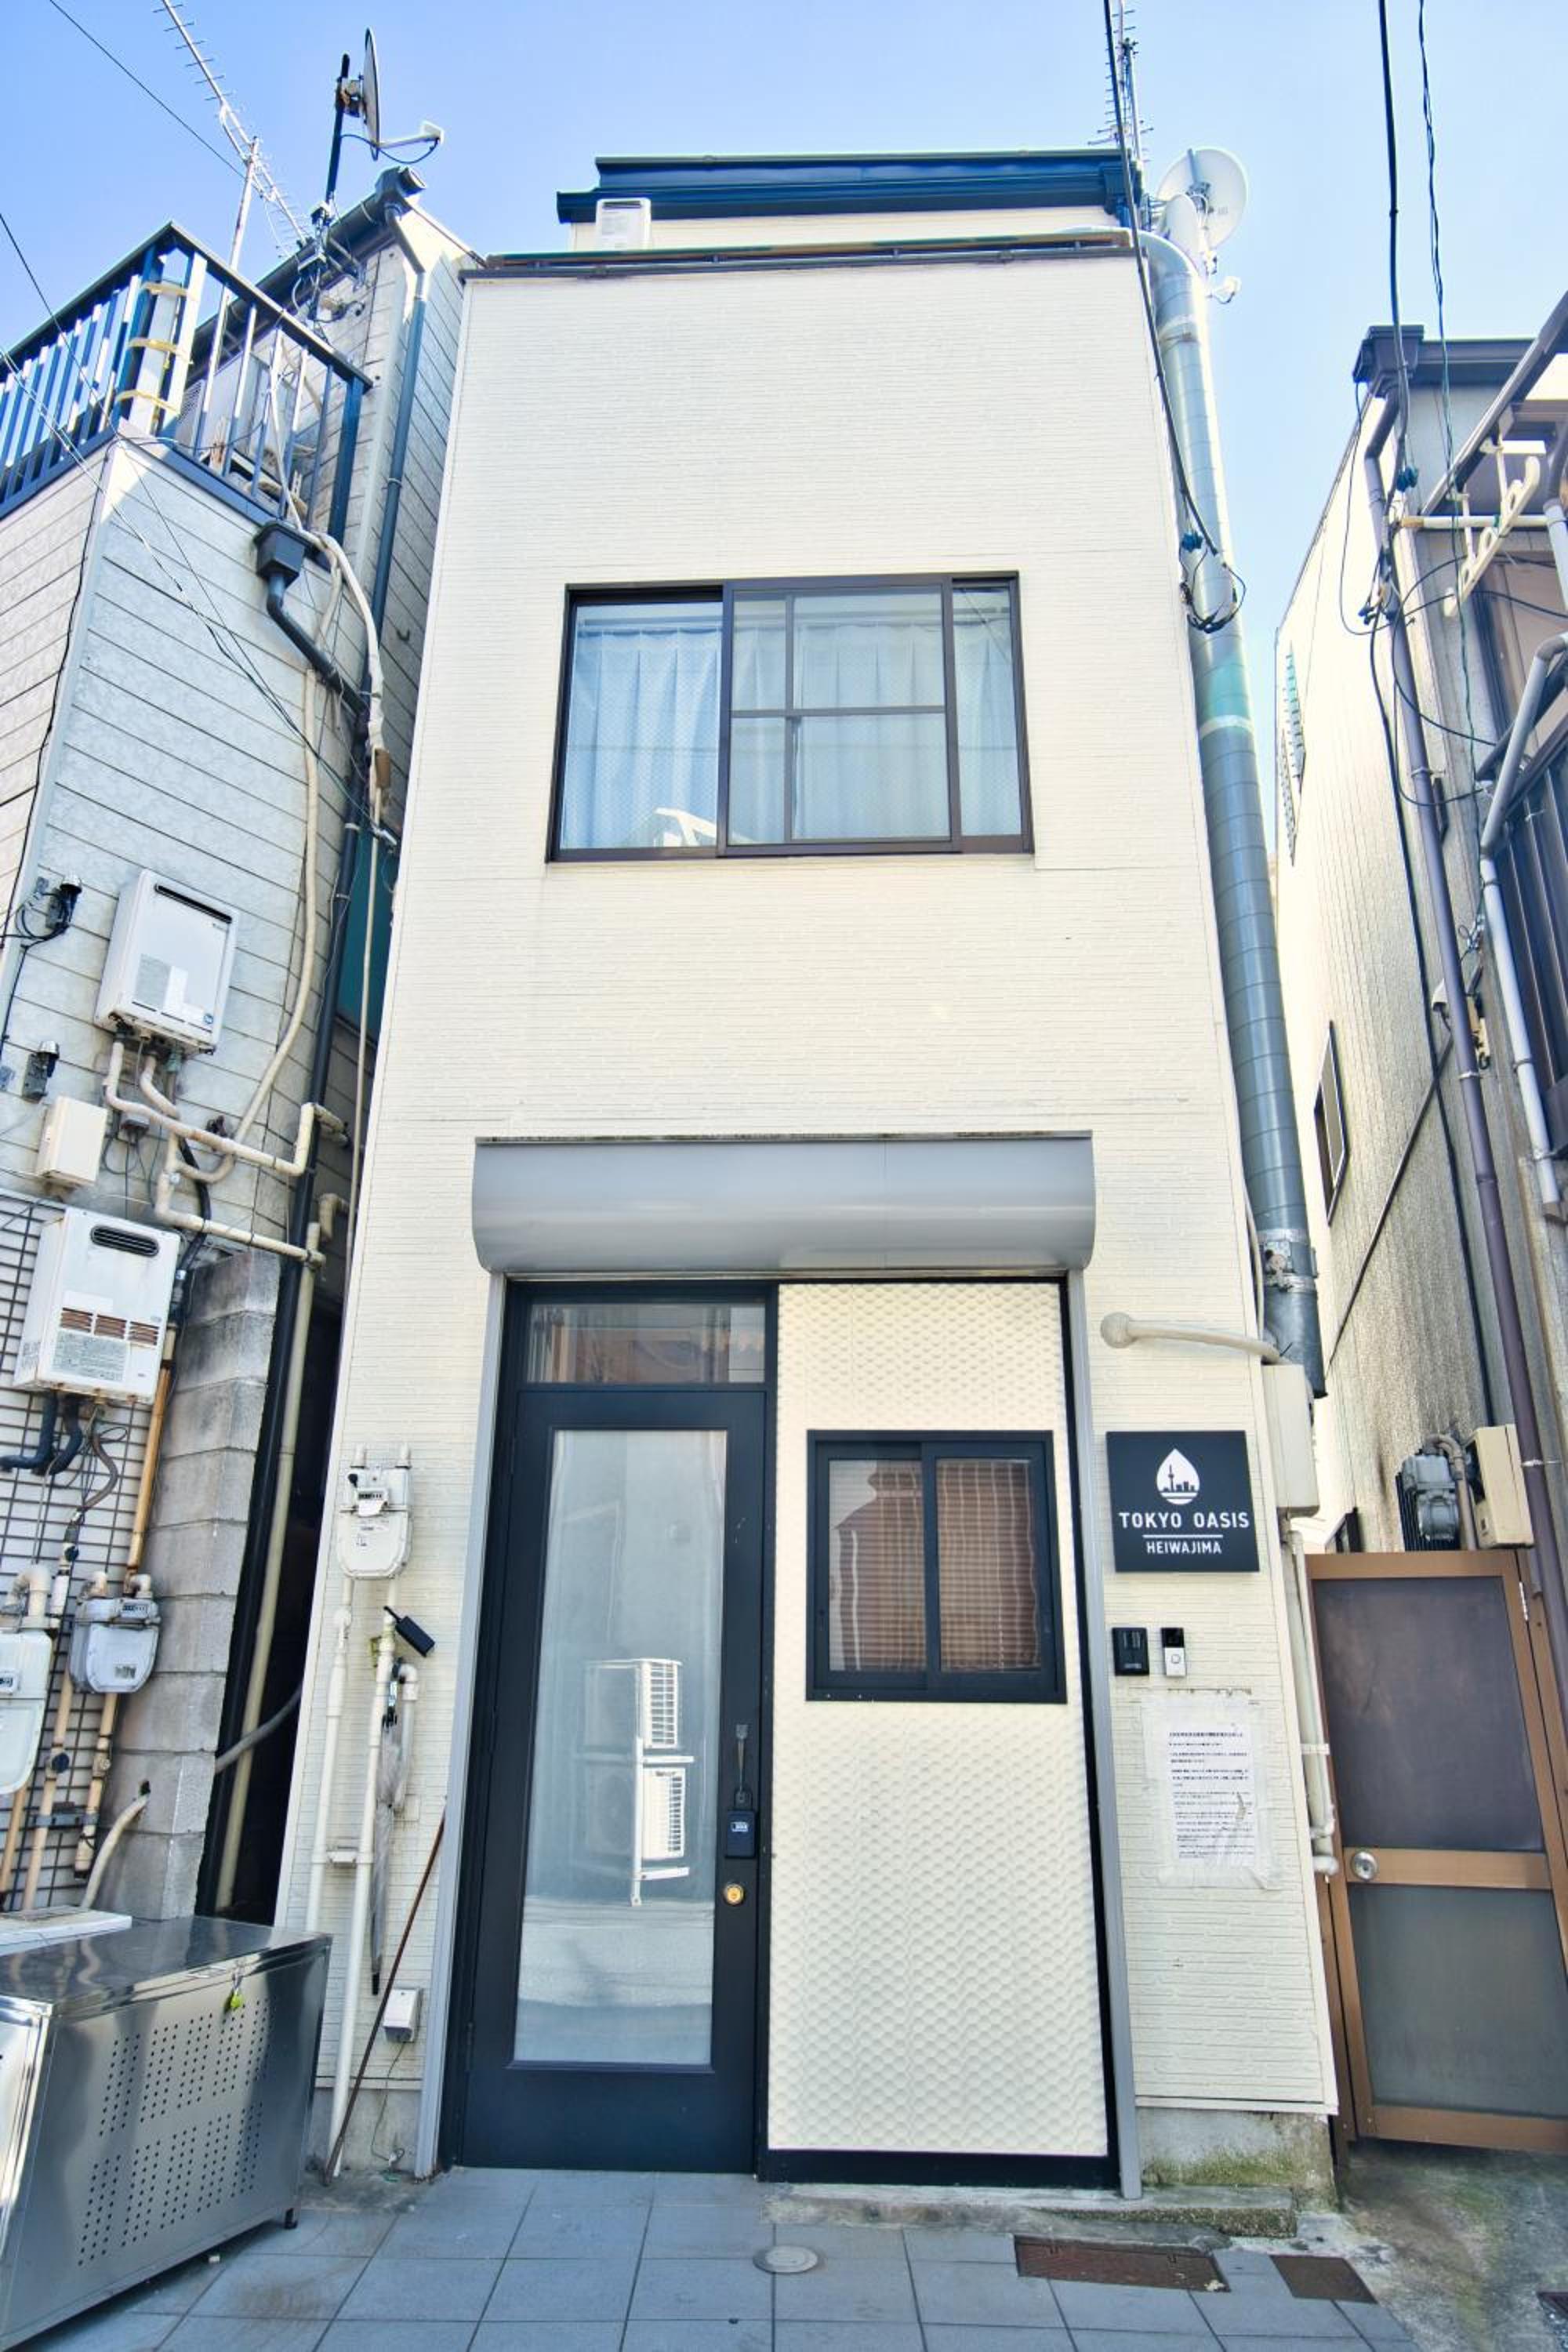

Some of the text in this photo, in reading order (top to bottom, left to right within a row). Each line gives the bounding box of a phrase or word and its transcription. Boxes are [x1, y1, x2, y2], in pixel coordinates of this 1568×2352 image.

[1119, 1512, 1250, 1528] TOKYO OASIS
[1146, 1541, 1222, 1555] HEIWAJIMA
